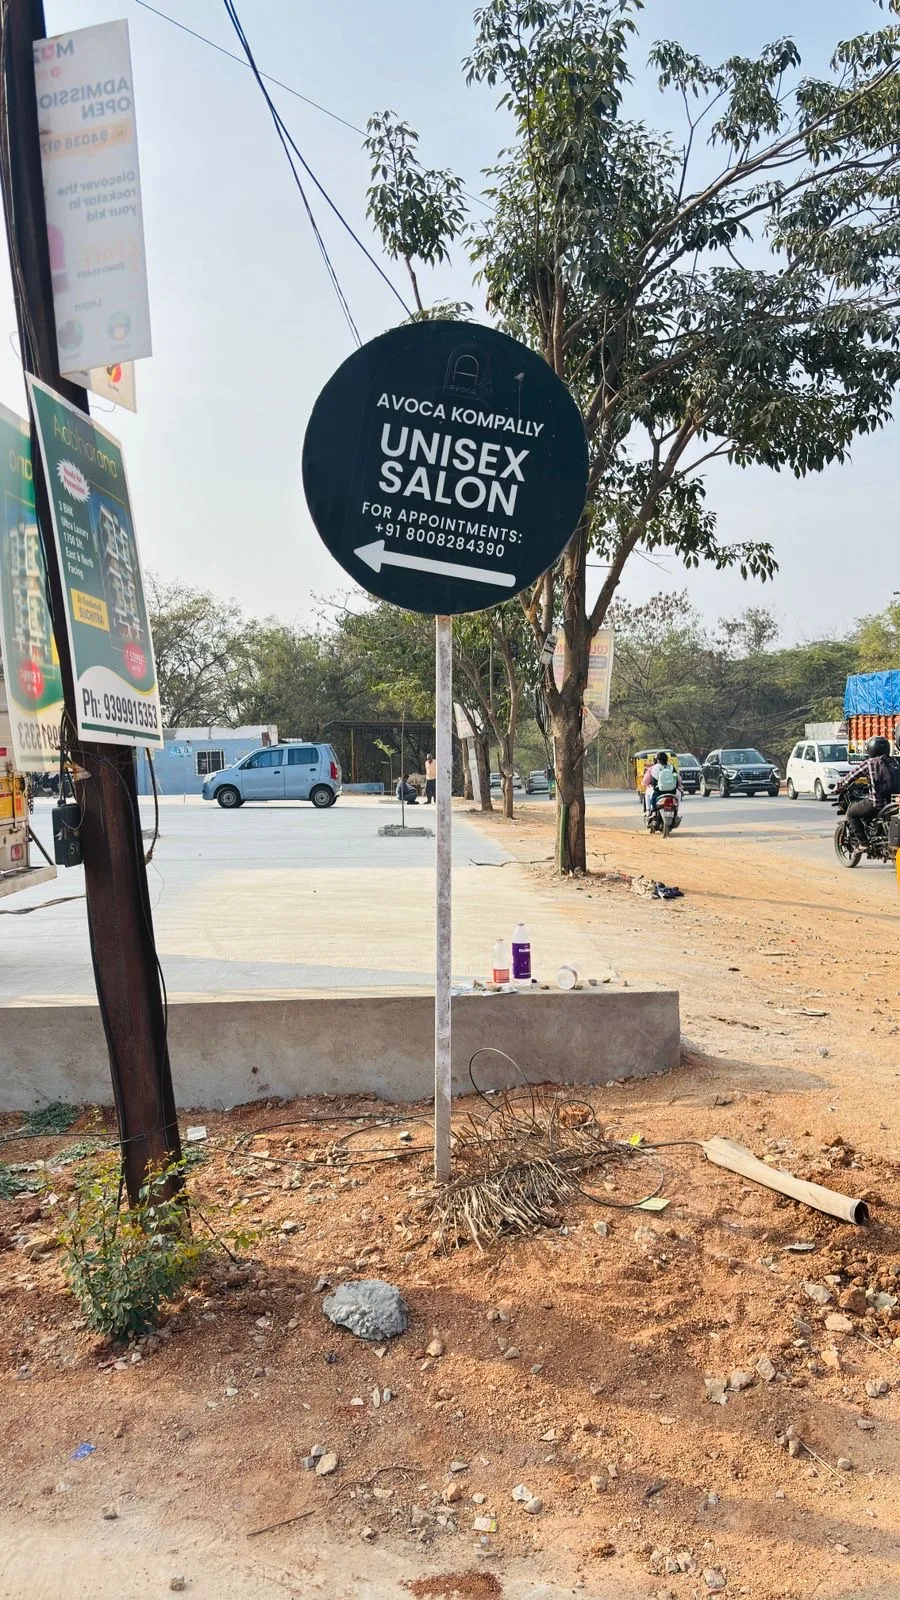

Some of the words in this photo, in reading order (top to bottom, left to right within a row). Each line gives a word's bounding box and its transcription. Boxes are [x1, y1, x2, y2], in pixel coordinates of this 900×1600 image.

[377, 393, 446, 419] AVOCA
[451, 406, 544, 437] KOMPALLY
[380, 423, 530, 482] UNISEX
[379, 460, 518, 516] SALON
[61, 516, 74, 531] Ultra
[73, 523, 89, 541] Luxury
[362, 502, 392, 519] FOR
[398, 509, 523, 544] APPOINTMENTS:
[375, 523, 400, 538] +91
[406, 527, 505, 557] 8008284390
[66, 546, 76, 560] East
[80, 555, 95, 569] North
[67, 561, 84, 580] Facing
[82, 687, 102, 719] Ph:
[104, 693, 158, 729] 9399915353
